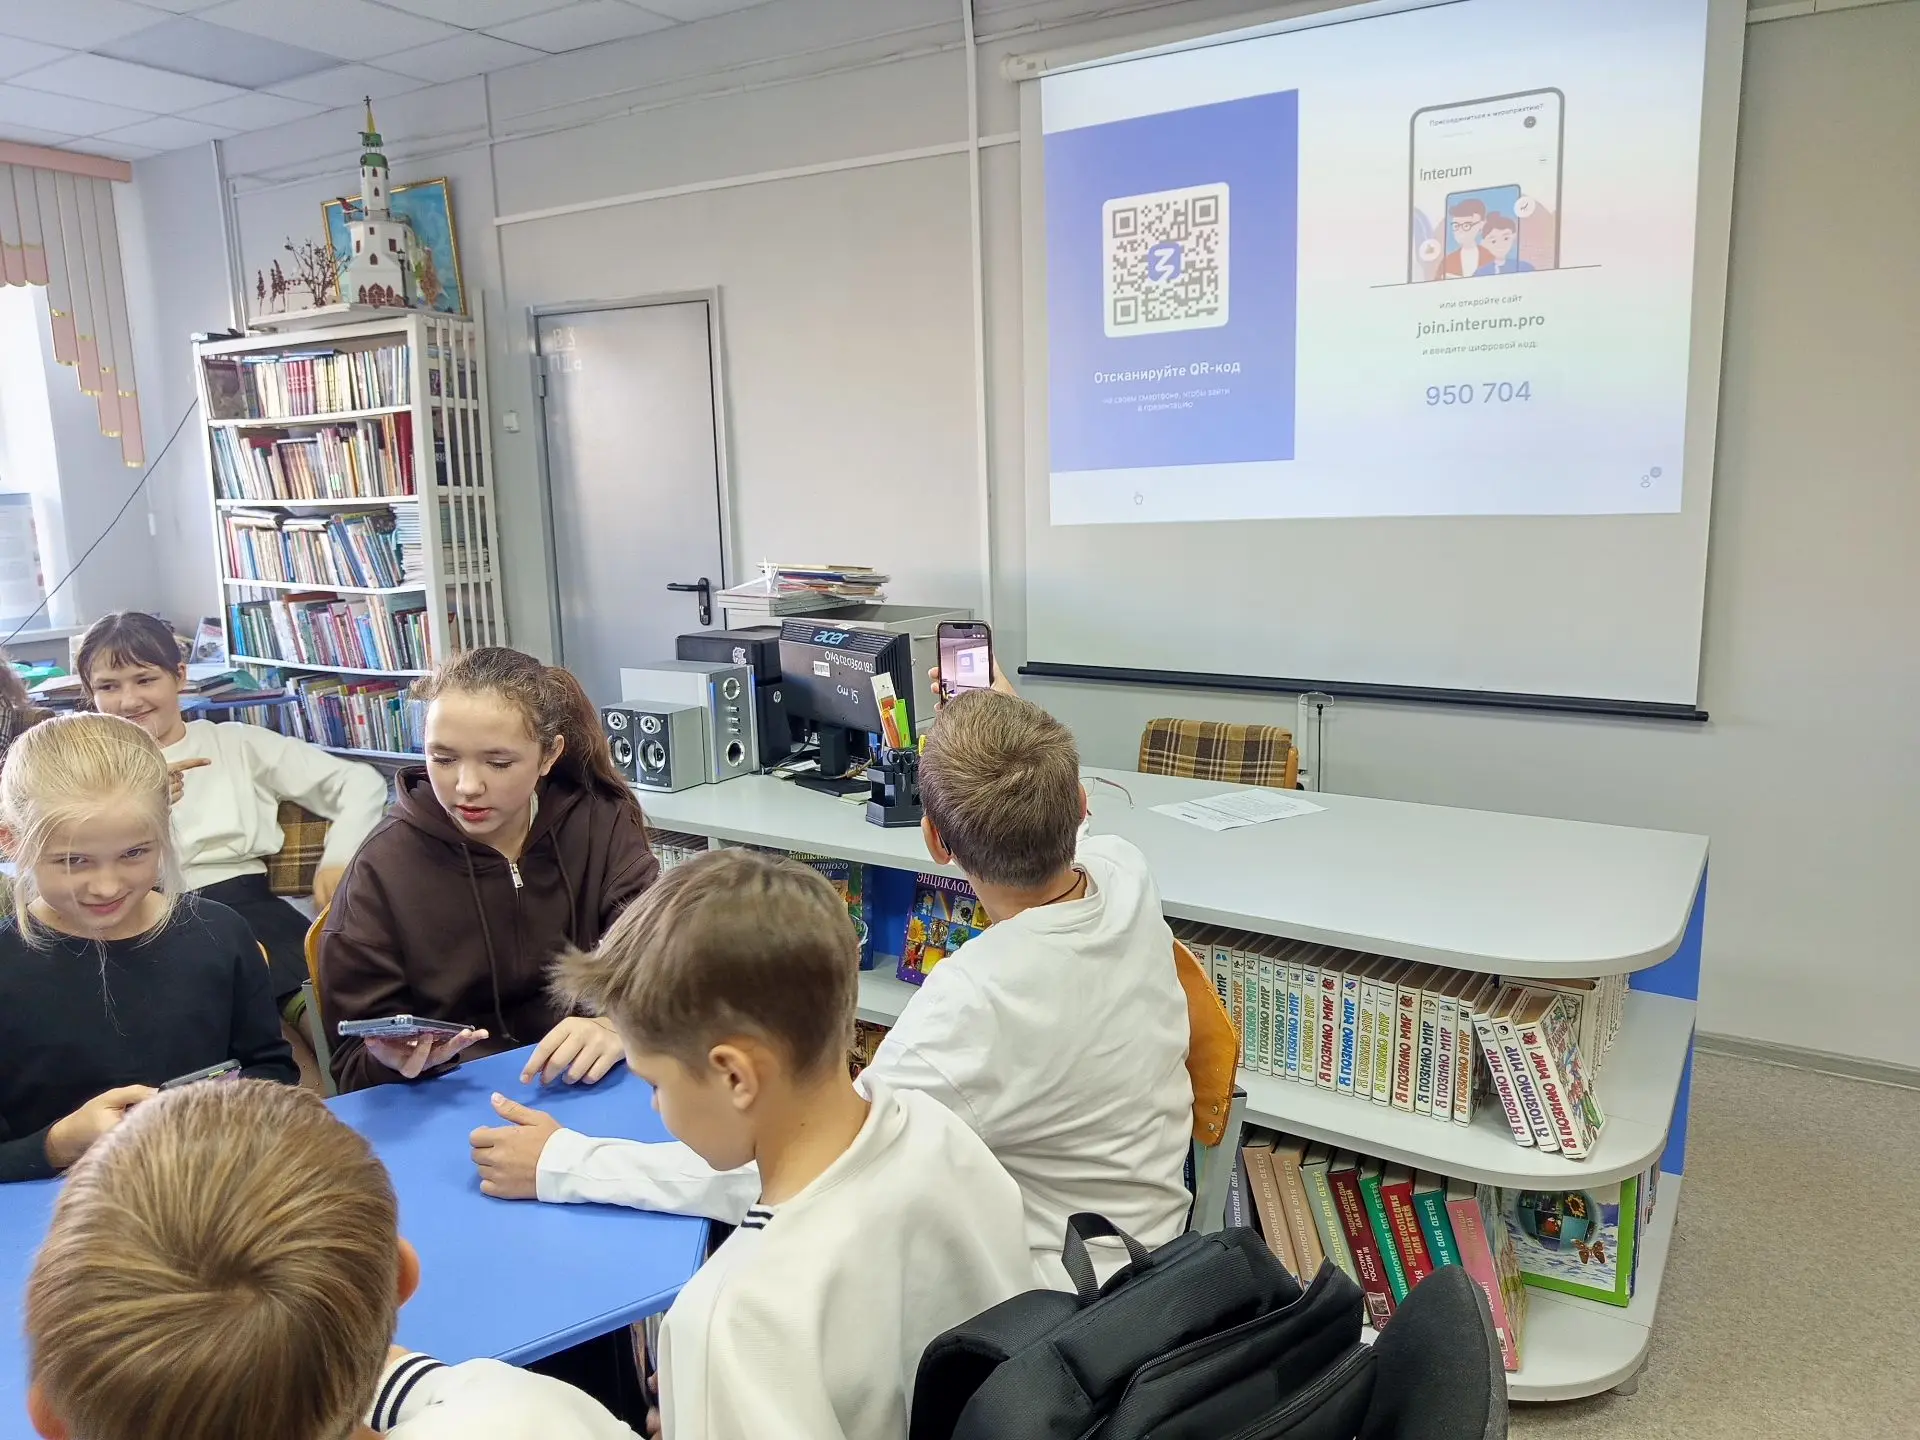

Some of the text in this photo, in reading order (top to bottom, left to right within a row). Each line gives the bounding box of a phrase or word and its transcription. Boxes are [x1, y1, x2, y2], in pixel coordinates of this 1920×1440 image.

[1420, 165, 1472, 181] Interum
[1458, 297, 1500, 308] откройте
[1502, 294, 1522, 304] сайт
[1416, 315, 1545, 339] join.interum.pro
[1468, 341, 1516, 353] цифровой
[1094, 361, 1241, 384] Отсканируйте QR-код
[1426, 380, 1532, 406] 950 704
[814, 630, 849, 645] acer
[1217, 974, 1227, 997] МИР
[1261, 985, 1270, 1010] МИР
[1276, 989, 1285, 1013] МИР
[1289, 993, 1299, 1017] МИР
[1322, 995, 1334, 1021] МИР
[1344, 998, 1355, 1025] МИР
[1259, 1011, 1270, 1055] ПОЗНАЮ
[1274, 1014, 1284, 1058] ПОЗНАЮ
[1400, 1013, 1412, 1040] МИР
[1422, 1021, 1434, 1046] МИР
[1287, 1018, 1298, 1063] ПОЗНАЮ
[1321, 1024, 1333, 1072] ПОЗНАЮ
[1341, 1027, 1354, 1075] ПОЗНАЮ
[1440, 1027, 1452, 1052] МИР
[1459, 1029, 1470, 1056] МИР
[1259, 1056, 1268, 1064] Я
[1274, 1059, 1284, 1068] Я
[1287, 1062, 1296, 1071] Я
[1397, 1042, 1411, 1092] ПОЗНАЮ
[1419, 1047, 1432, 1094] ПОЗНАЮ
[1485, 1048, 1504, 1073] МИР
[1504, 1046, 1524, 1072] МИР
[1529, 1052, 1551, 1080] МИР
[1319, 1071, 1331, 1082] Я
[1339, 1075, 1350, 1087] Я
[1437, 1054, 1450, 1099] ПОЗНАЮ
[1456, 1056, 1469, 1106] ПОЗНАЮ
[1395, 1092, 1408, 1103] Я
[1417, 1093, 1429, 1103] Я
[1436, 1099, 1447, 1108] Я
[1456, 1105, 1467, 1115] Я
[1496, 1076, 1520, 1127] ПОЗНАЮ
[1516, 1074, 1544, 1128] ПОЗНАЮ
[1543, 1082, 1572, 1136] ПОЗНАЮ
[1512, 1126, 1525, 1135] Я
[1535, 1127, 1550, 1138] Я
[1562, 1136, 1577, 1149] Я
[1256, 1152, 1268, 1179] ДЕТЕЙ
[1263, 1182, 1272, 1199] ДЛЯ
[1313, 1171, 1327, 1197] ДЕТЕЙ
[1369, 1181, 1384, 1209] ДЕТЕЙ
[1283, 1159, 1314, 1277] ЭНЦИКЛОПЕДИЯ ДЛЯ ДЕТЕЙ
[1321, 1200, 1331, 1217] ДЛЯ
[1336, 1181, 1358, 1237] ЭНЦИКЛОПЕДИЯ
[1346, 1189, 1363, 1228] ДЛЯ ДЕТЕЙ
[1379, 1211, 1390, 1229] ДЛЯ
[1401, 1204, 1417, 1233] ДЕТЕЙ
[1424, 1199, 1439, 1227] ДЕТЕЙ
[1389, 1194, 1417, 1267] ЭНЦИКЛОПЕДИЯ
[1434, 1229, 1446, 1248] ДЛЯ
[1411, 1236, 1423, 1254] ДЛЯ
[1356, 1249, 1370, 1279] ИСТОРИЯ
[1365, 1255, 1378, 1282] РОССИИ
